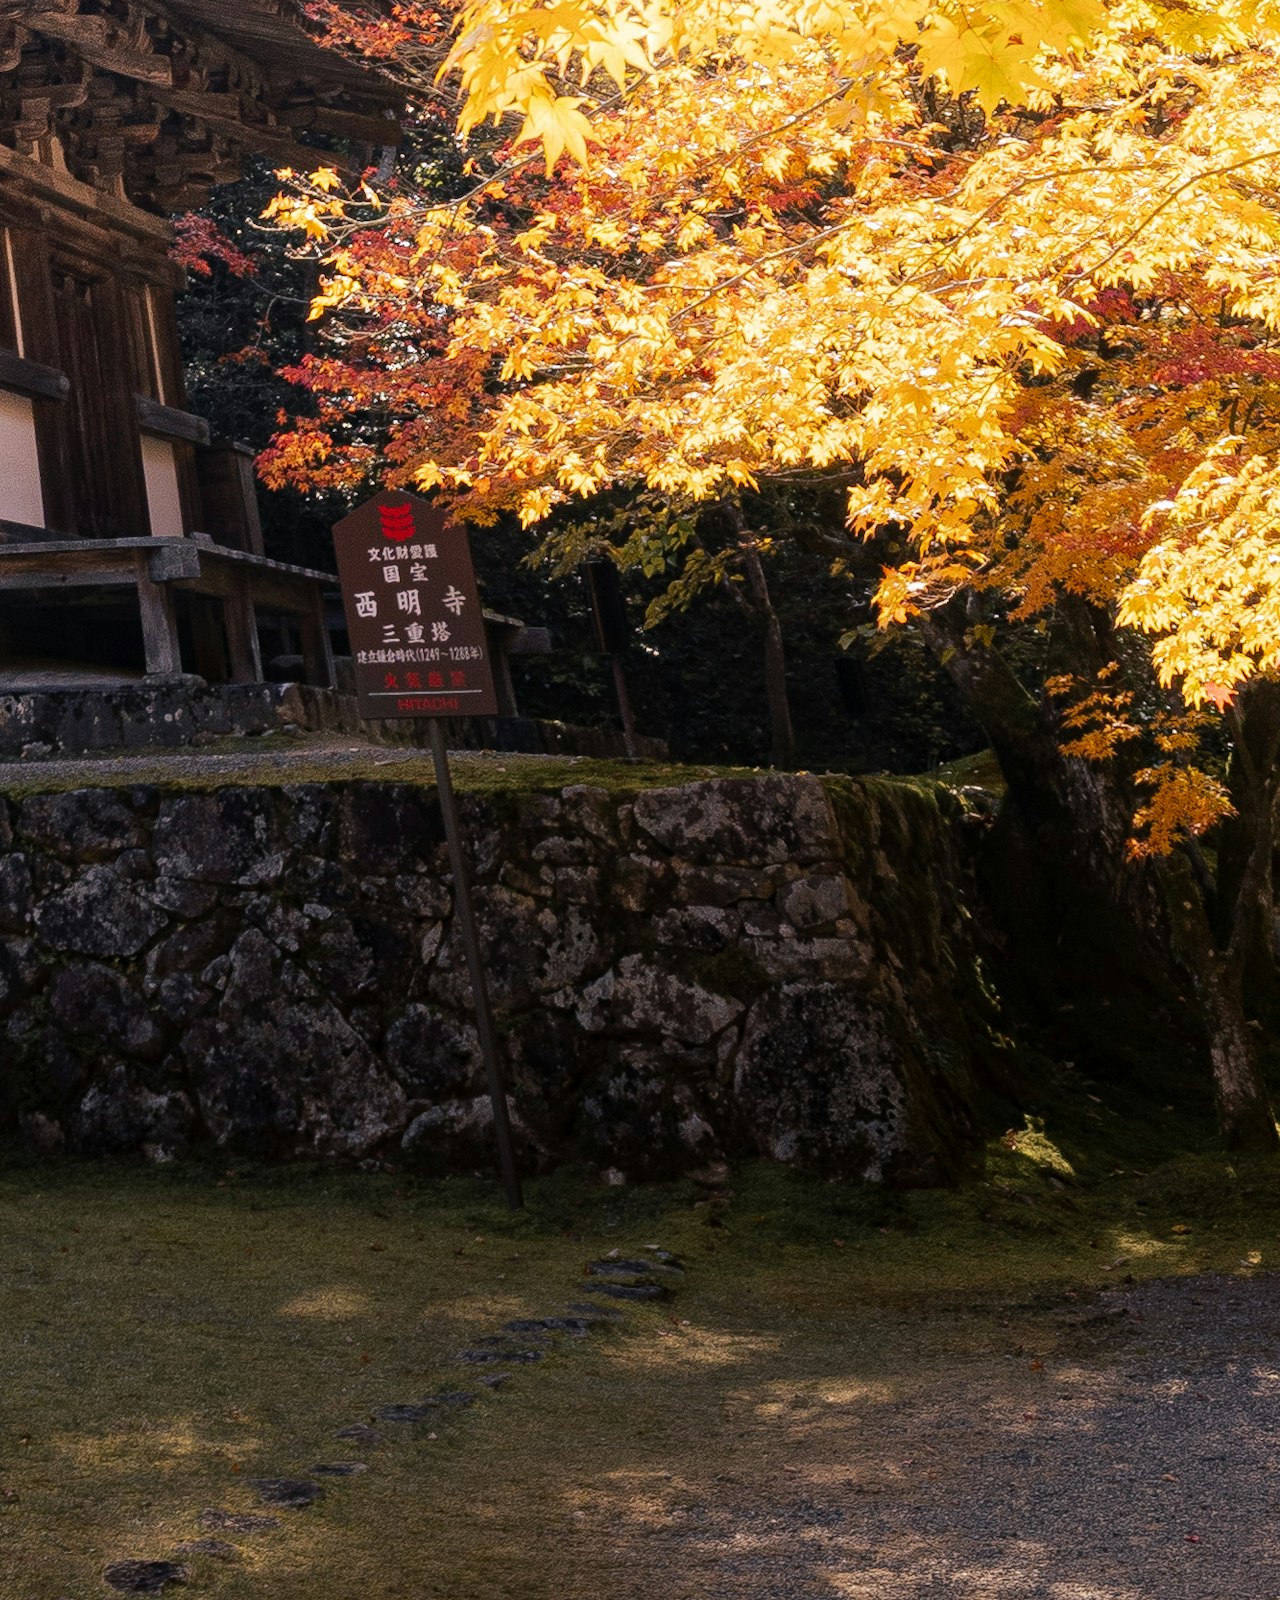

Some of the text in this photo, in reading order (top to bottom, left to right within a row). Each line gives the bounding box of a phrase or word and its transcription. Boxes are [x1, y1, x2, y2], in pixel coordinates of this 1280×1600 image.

[368, 544, 438, 562] 文化財愛護
[383, 562, 429, 583] 国宝
[354, 585, 467, 617] 西明寺
[382, 621, 452, 643] 三重塔
